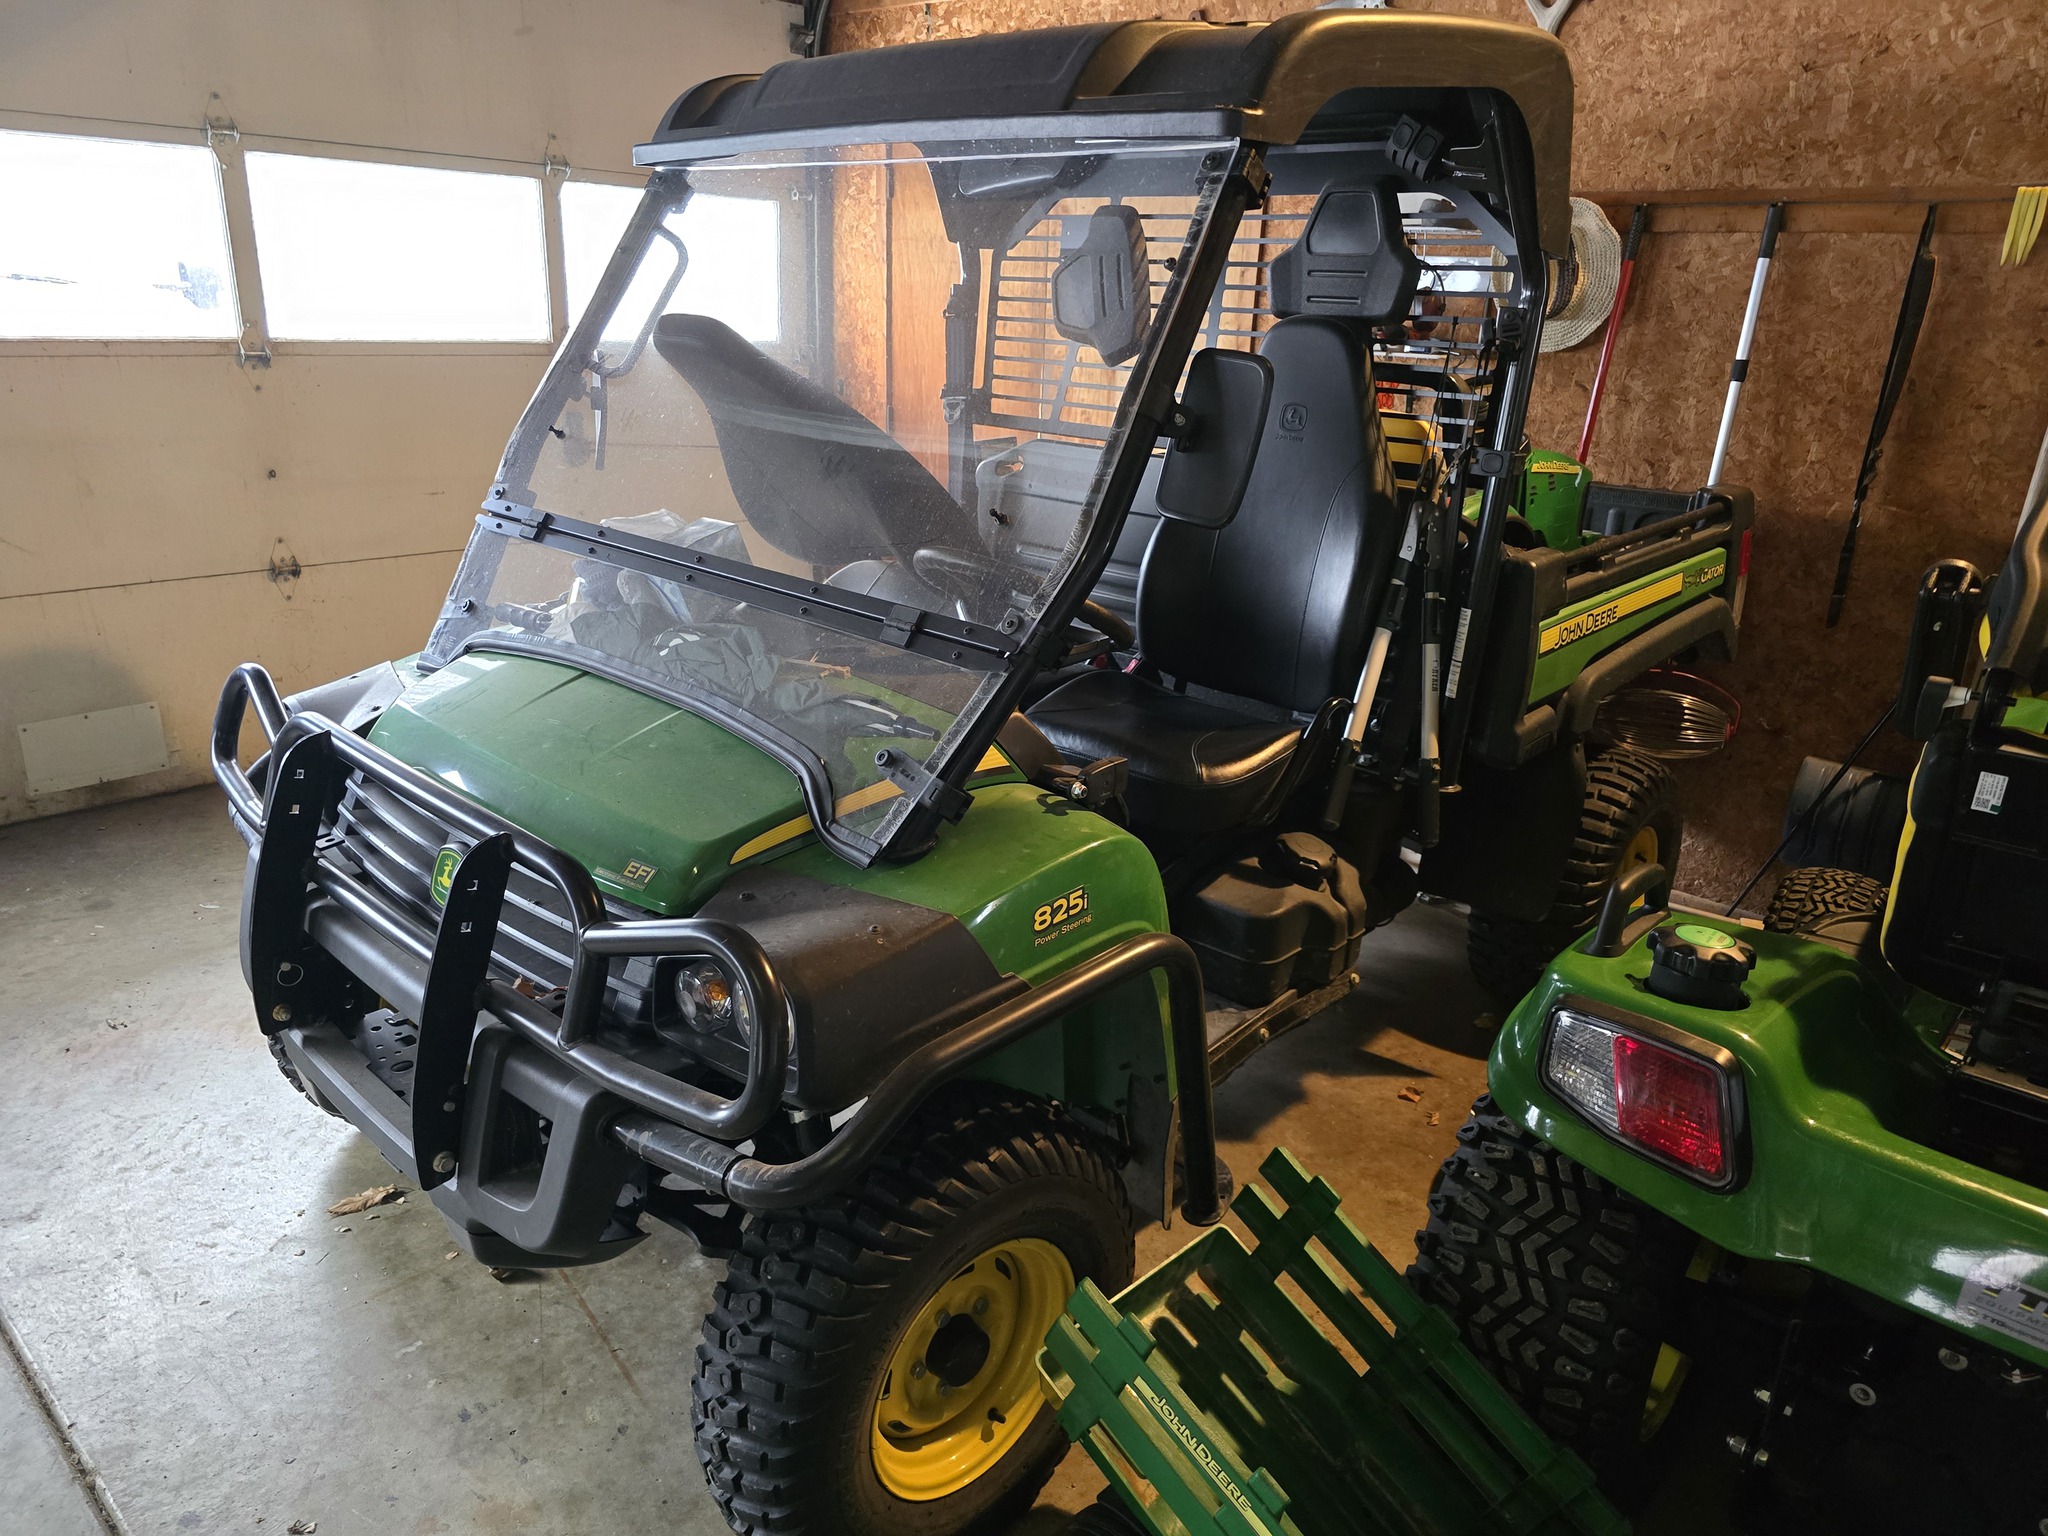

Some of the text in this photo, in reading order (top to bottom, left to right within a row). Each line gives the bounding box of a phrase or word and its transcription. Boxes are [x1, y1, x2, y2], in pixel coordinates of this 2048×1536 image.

[1701, 563, 1725, 583] GATOR
[1554, 604, 1619, 648] JOHN DEERE
[622, 861, 656, 884] EFI
[1033, 889, 1088, 931] 825i
[1034, 913, 1092, 948] Power Steering
[1152, 1396, 1252, 1512] JOHN DEERE
